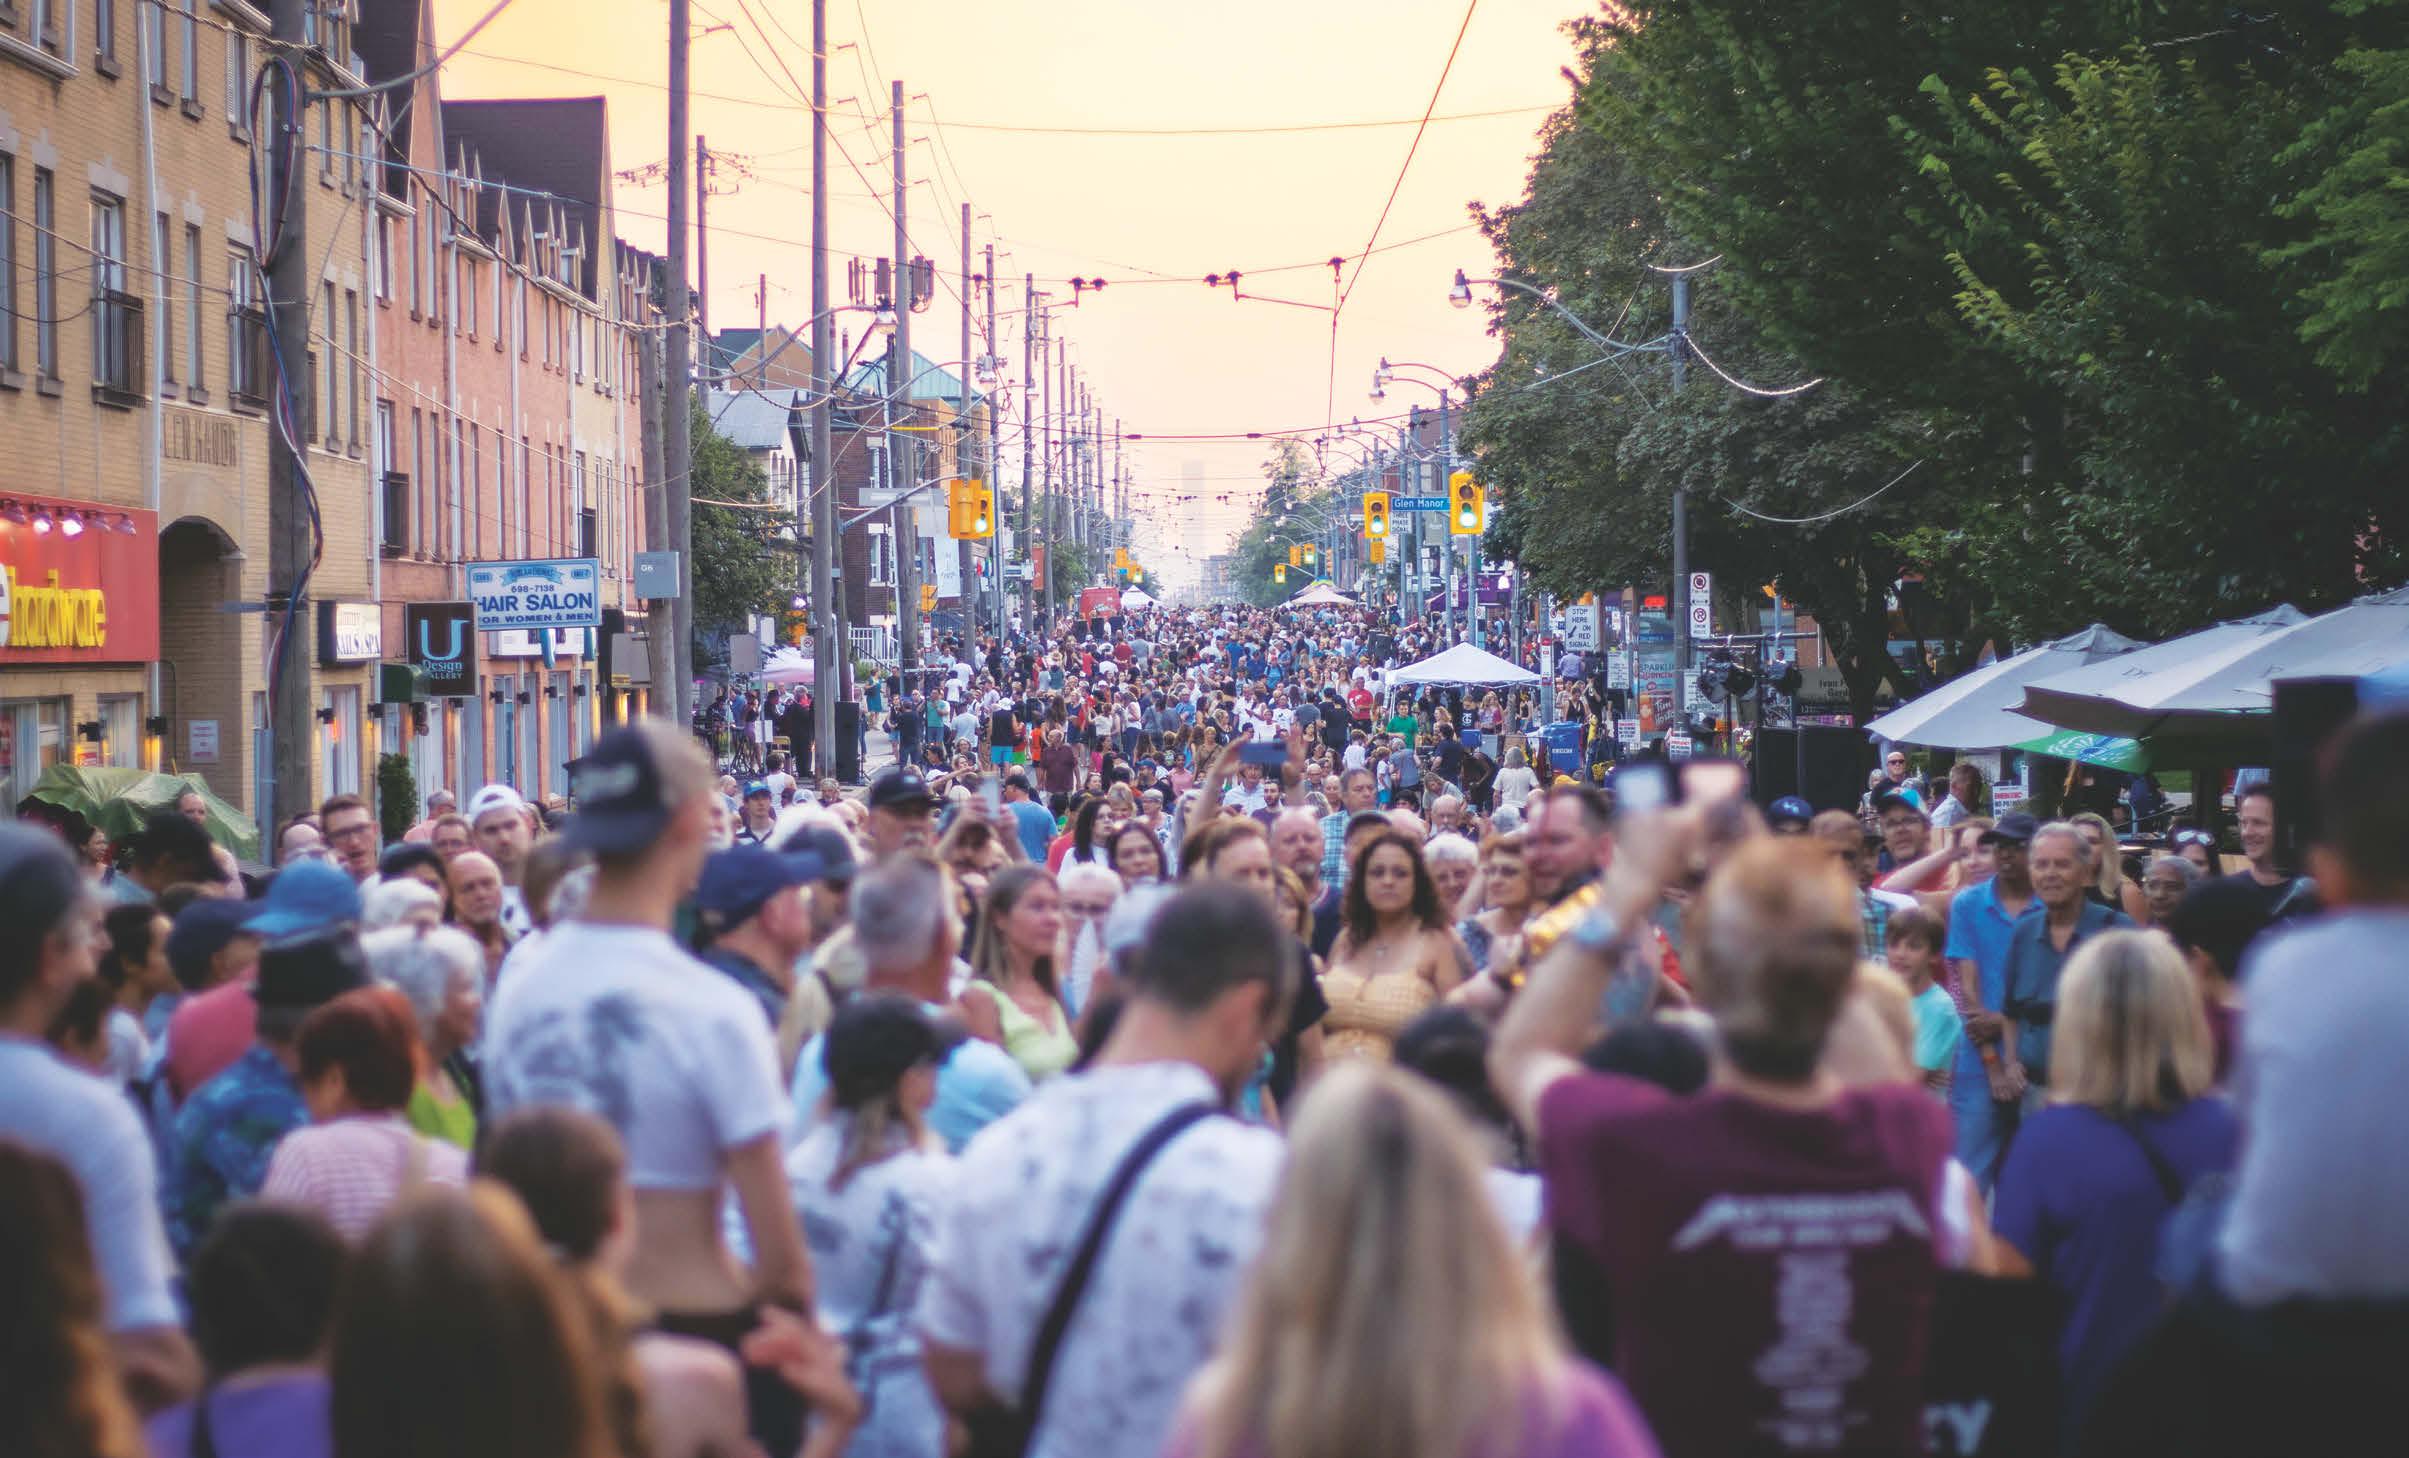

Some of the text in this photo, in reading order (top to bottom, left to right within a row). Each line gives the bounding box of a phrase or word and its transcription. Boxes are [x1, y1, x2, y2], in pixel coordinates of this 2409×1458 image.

[1394, 500, 1414, 508] Glen
[1418, 500, 1444, 508] Manor
[511, 584, 555, 593] 698-7138
[7, 565, 106, 647] hardware
[526, 592, 593, 610] SALON
[479, 612, 593, 623] OR WOMEN & MEN
[420, 619, 471, 660] U
[422, 660, 463, 673] Design
[1655, 698, 1672, 712] Tim
